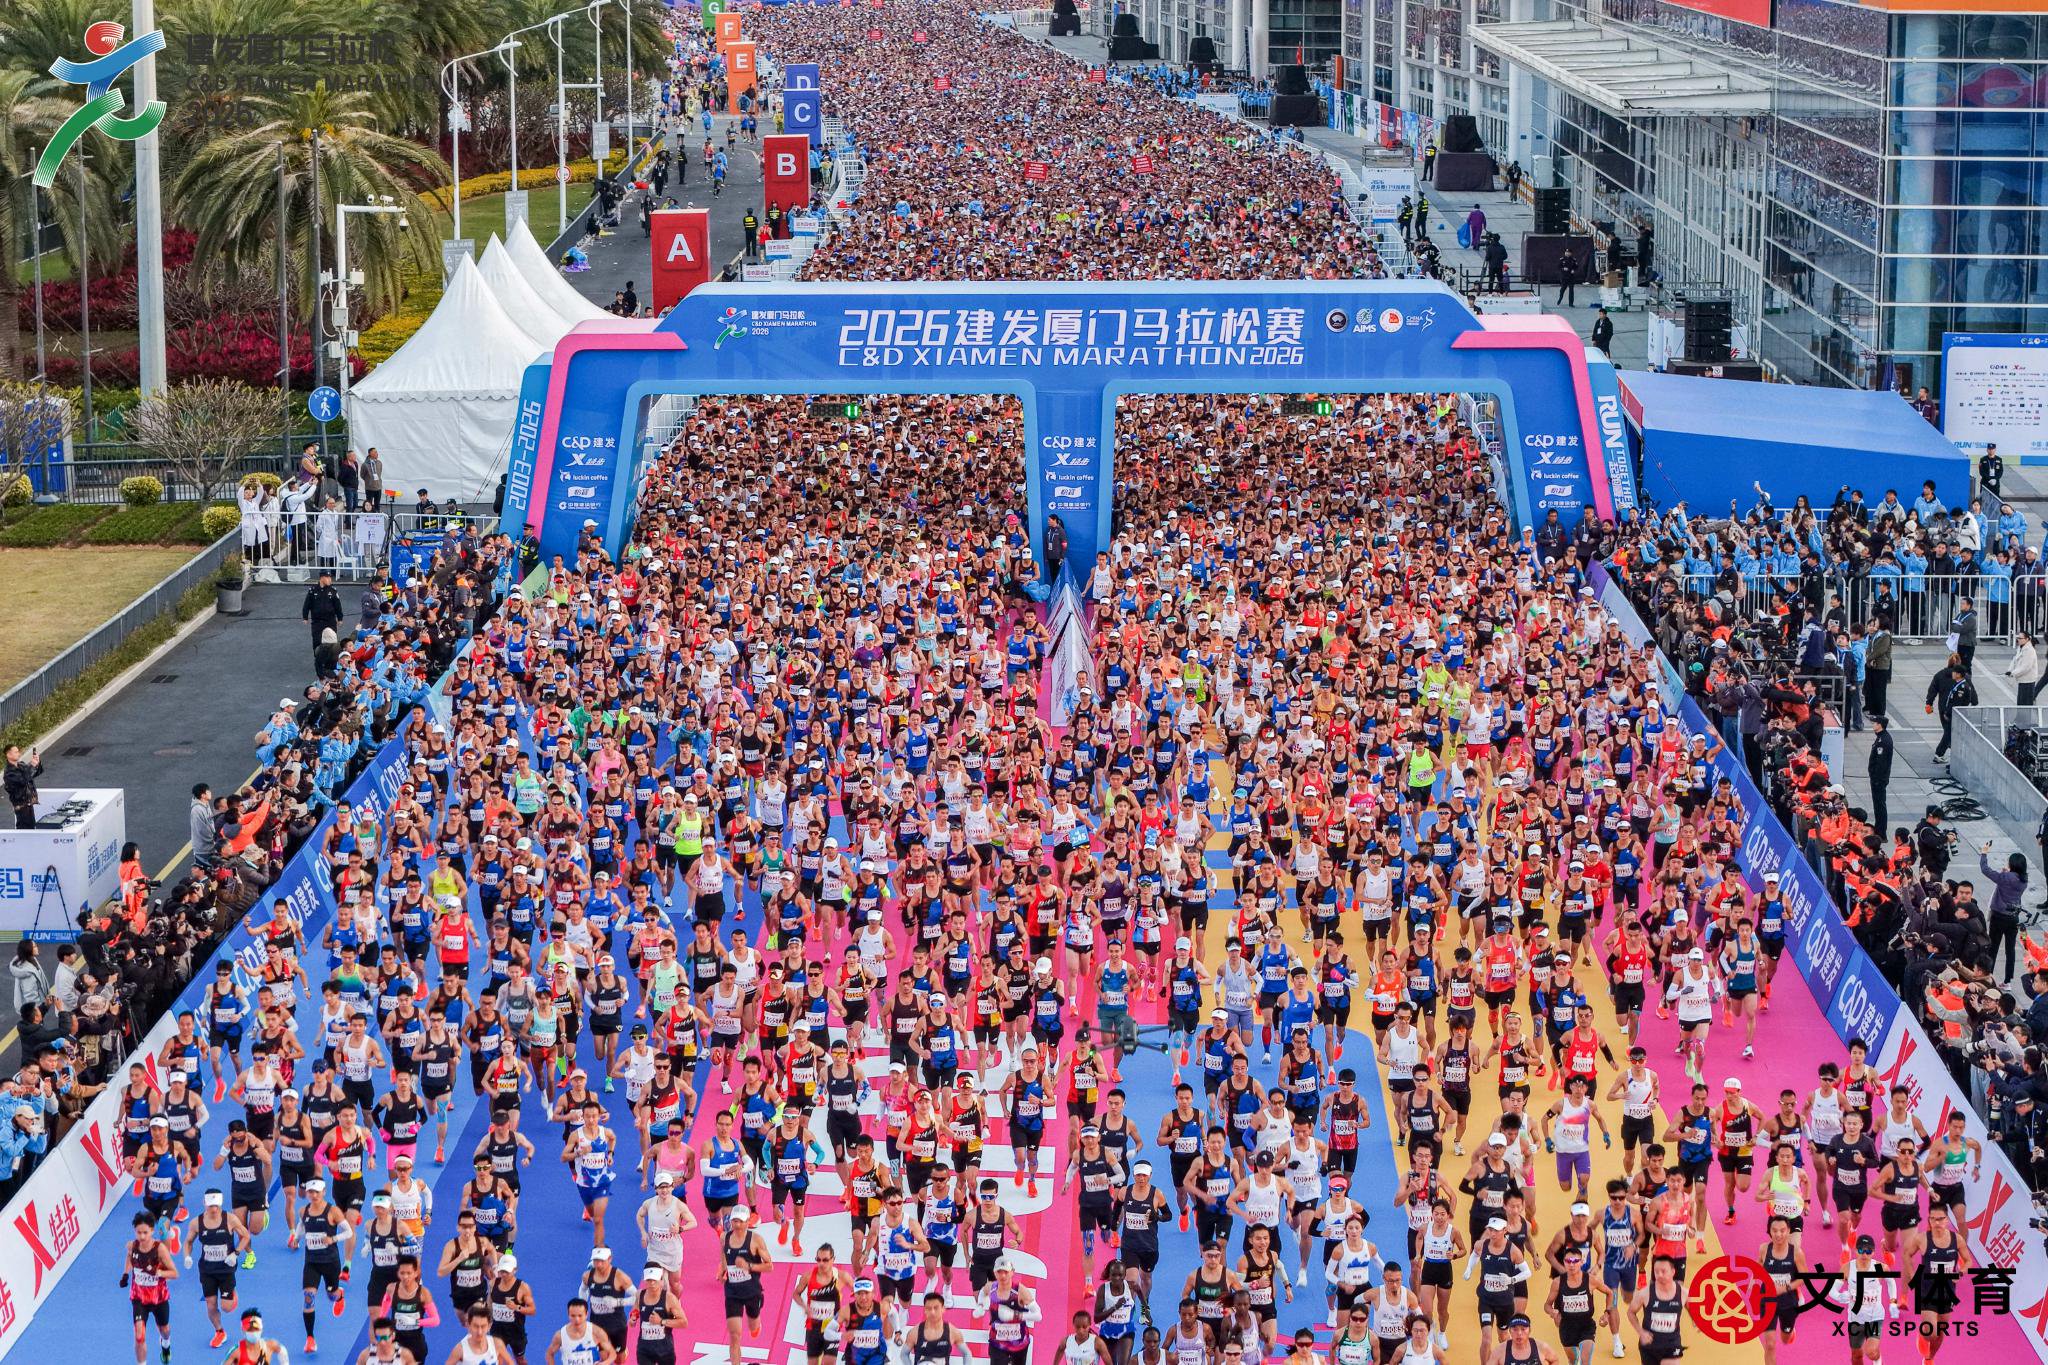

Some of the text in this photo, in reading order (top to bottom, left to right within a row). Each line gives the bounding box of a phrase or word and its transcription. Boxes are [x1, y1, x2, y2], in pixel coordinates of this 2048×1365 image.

[708, 2, 720, 14] G
[724, 22, 734, 36] F
[736, 53, 748, 69] E
[796, 75, 812, 89] D
[794, 103, 811, 123] C
[777, 153, 797, 176] B
[666, 233, 695, 262] A
[751, 328, 769, 336] 2026
[839, 307, 1305, 347] 2026建发厦门马拉松赛
[1353, 325, 1377, 333] AIMS
[839, 347, 904, 367] C&D
[912, 347, 1042, 366] XIAMEN
[1597, 394, 1624, 448] RUN
[562, 435, 616, 450] C&D 建发
[1042, 435, 1097, 450] C&D 建发
[1524, 434, 1579, 449] C&D 建发
[508, 400, 541, 511] 2003-2026
[1616, 449, 1634, 509] TOGETHER
[1745, 824, 1769, 875] C&D
[31, 874, 57, 884] RUN
[1790, 891, 1813, 938] 建发
[28, 932, 51, 941] RUN
[1806, 917, 1843, 993] C&D 建发
[1838, 973, 1885, 1053] C&D 建发
[48, 1192, 81, 1262] 特步
[1985, 1222, 2026, 1271] 特步
